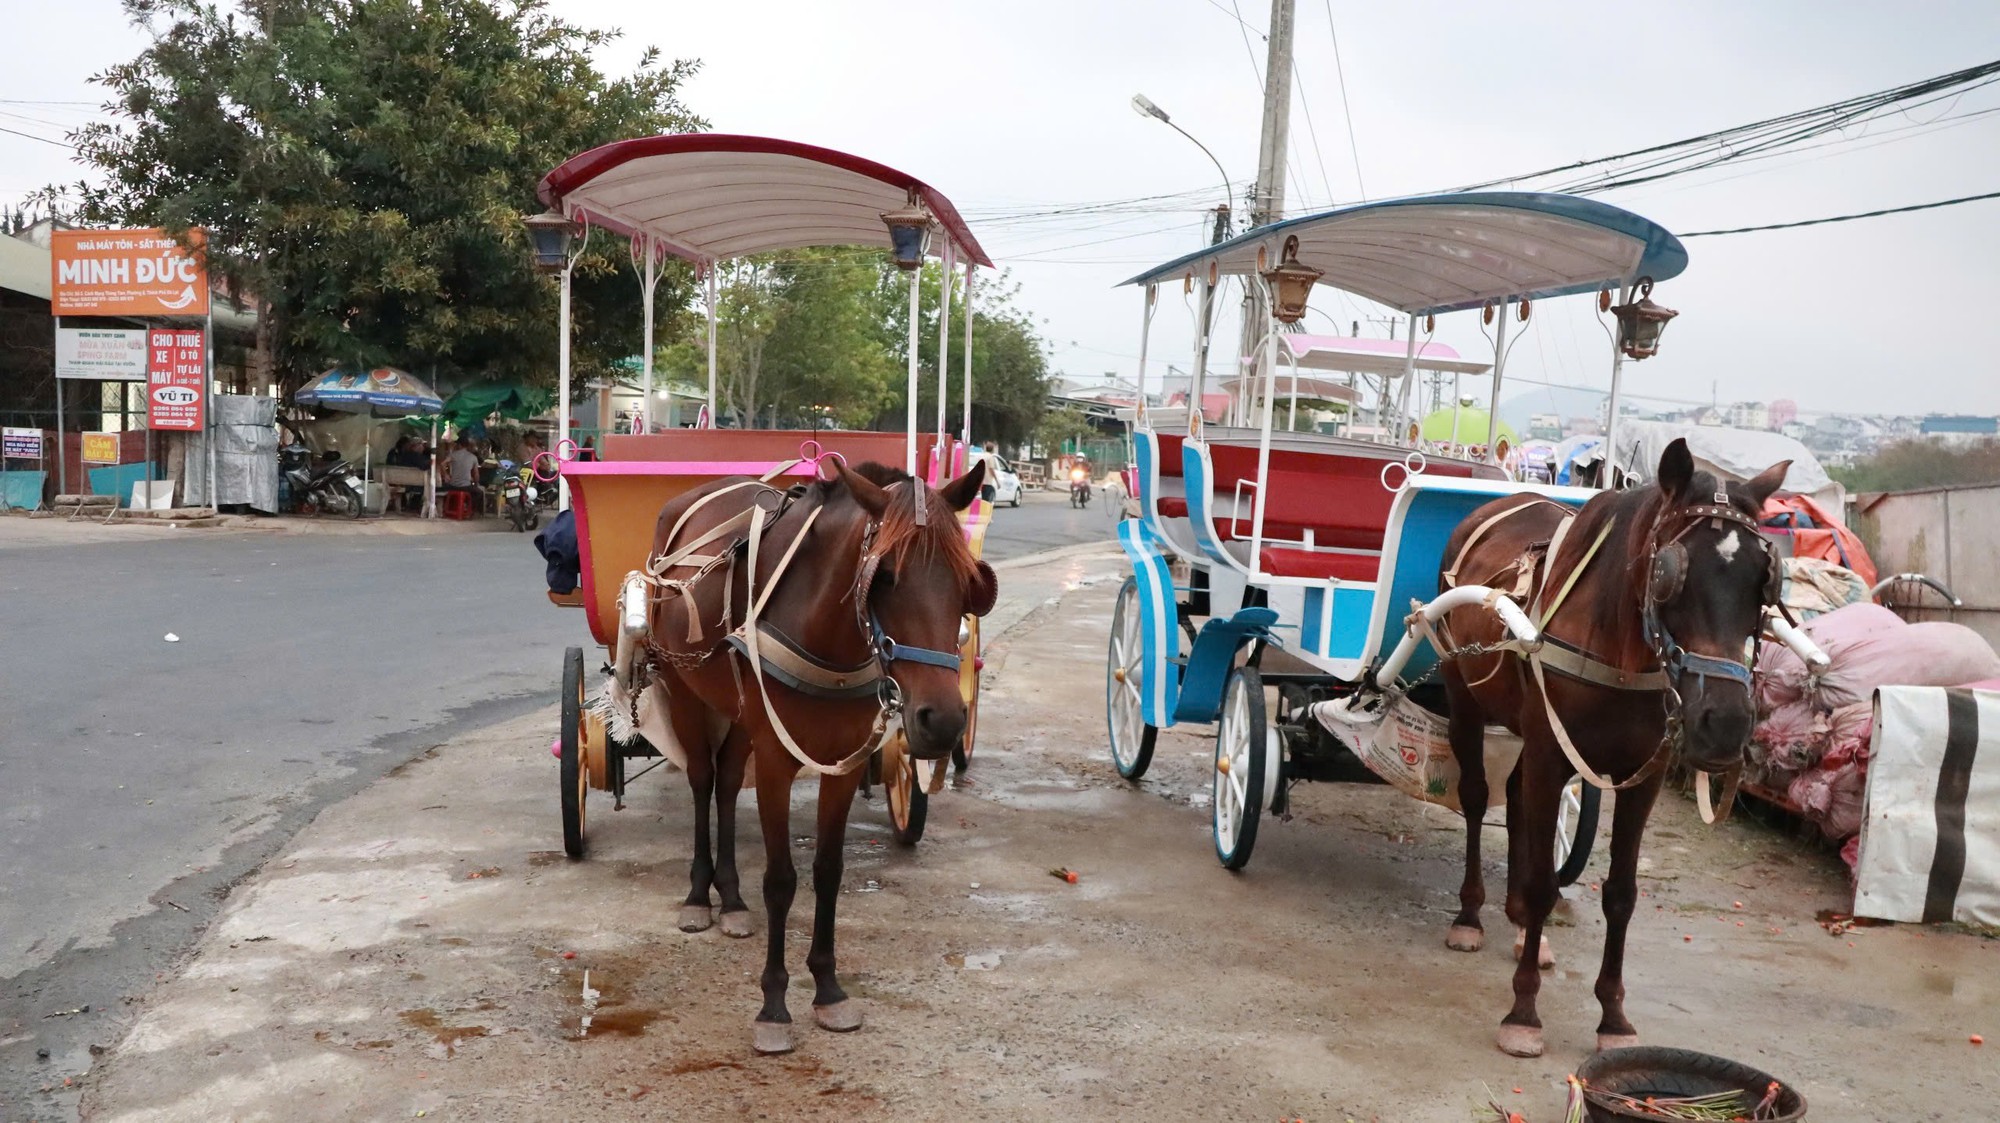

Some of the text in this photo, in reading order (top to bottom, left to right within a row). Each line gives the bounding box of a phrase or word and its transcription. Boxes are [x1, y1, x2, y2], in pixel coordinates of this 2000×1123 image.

[77, 240, 95, 250] NHÀ
[96, 239, 114, 250] MÁY
[115, 239, 133, 250] TÔN
[139, 239, 154, 249] SẮT
[58, 250, 197, 285] MINH ĐỨC
[153, 334, 173, 347] CHO
[156, 350, 168, 363] XE
[180, 349, 198, 360] Ô TÔ
[176, 363, 201, 376] TỰ LÁI
[151, 369, 172, 384] MÁY
[159, 390, 193, 401] VŨ TI
